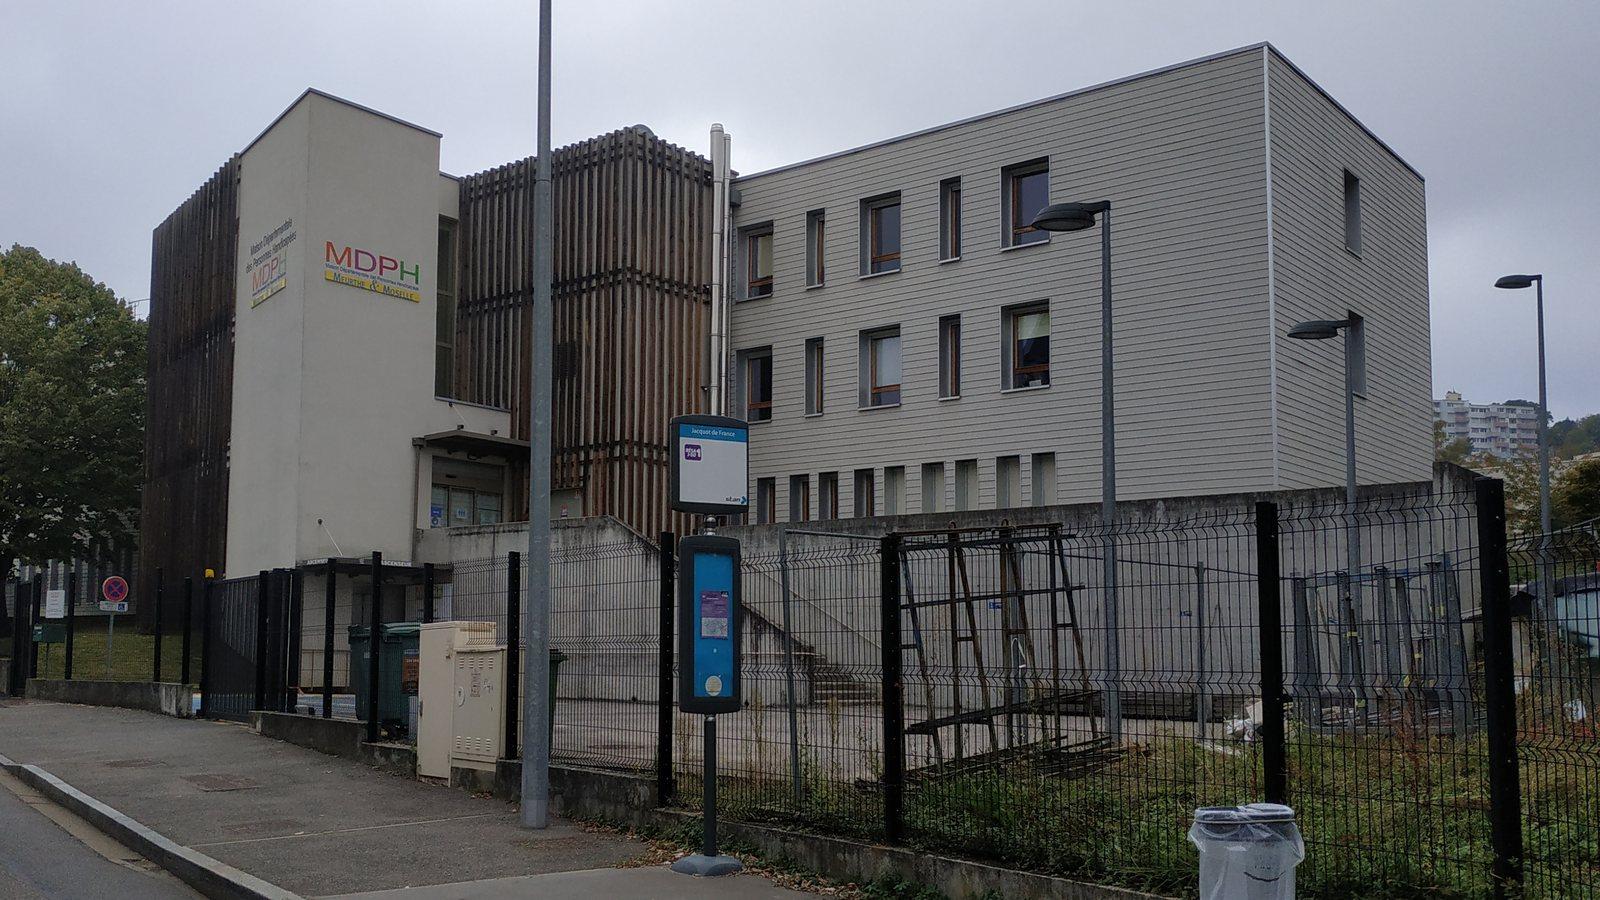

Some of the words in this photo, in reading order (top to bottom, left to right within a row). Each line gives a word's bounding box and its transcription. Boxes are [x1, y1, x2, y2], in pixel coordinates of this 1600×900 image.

[252, 250, 287, 291] MDPH
[326, 241, 419, 285] MDPH
[369, 279, 377, 291] &
[691, 428, 710, 436] Jacquot
